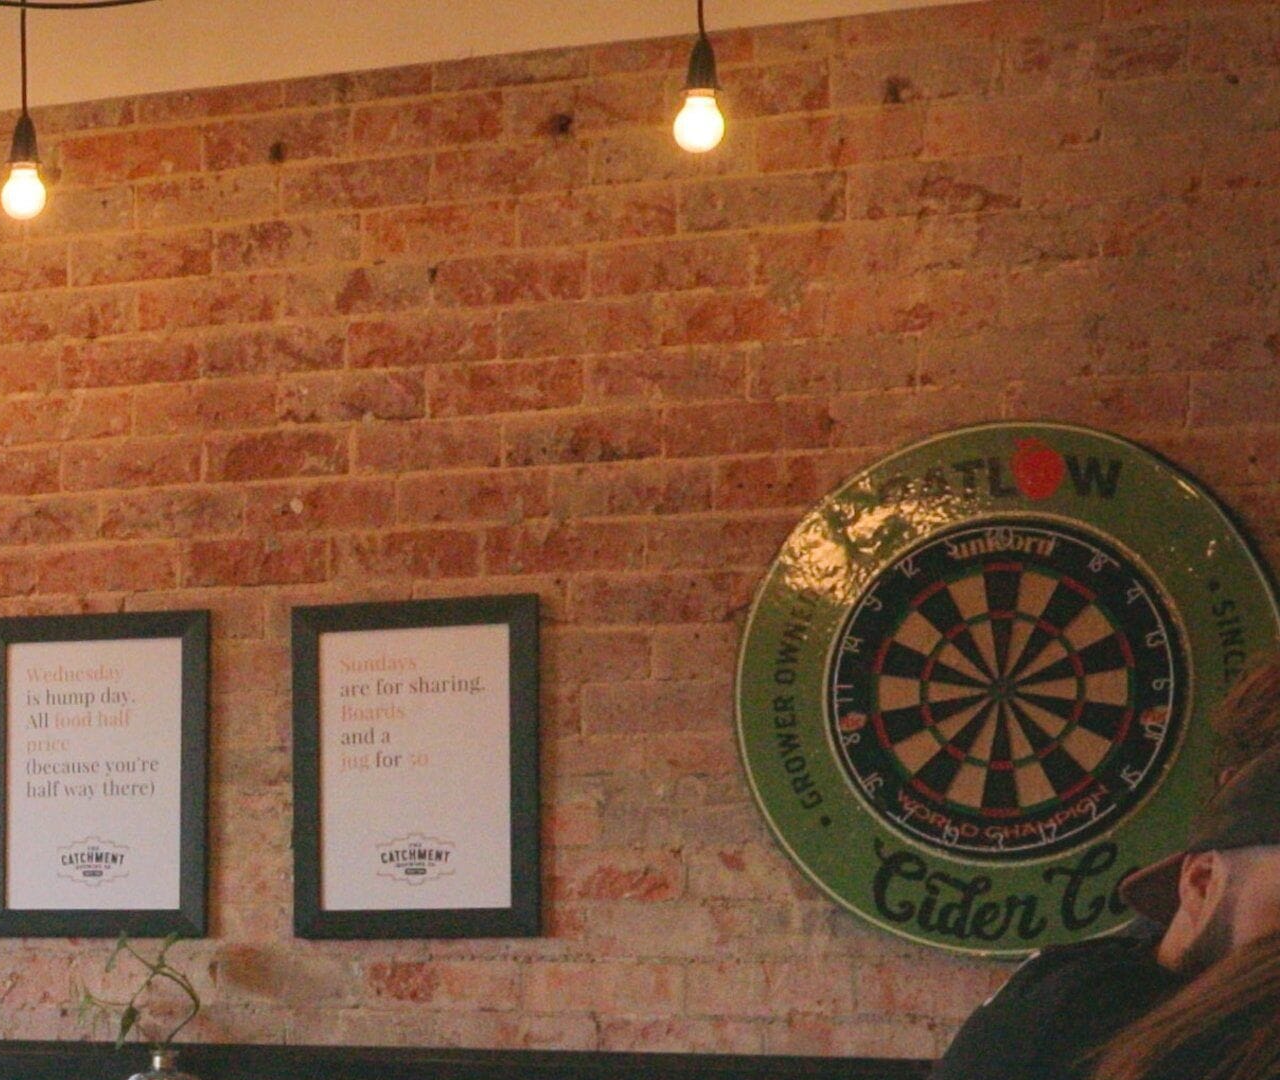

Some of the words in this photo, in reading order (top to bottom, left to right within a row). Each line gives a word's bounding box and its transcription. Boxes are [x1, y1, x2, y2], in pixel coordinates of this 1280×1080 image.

[340, 653, 417, 674] Sundays
[26, 665, 122, 685] Wednesday
[340, 683, 370, 698] are
[376, 678, 404, 695] for
[409, 675, 486, 695] sharing.
[26, 690, 40, 706] is
[46, 689, 96, 708] hump
[100, 687, 136, 707] day.
[25, 712, 49, 730] All
[54, 711, 92, 729] food
[98, 708, 133, 728] half
[341, 703, 406, 722] Boards
[340, 727, 375, 746] and
[381, 730, 391, 744] a
[340, 752, 371, 773] jug
[376, 751, 403, 768] for
[774, 695, 824, 811] GROWER
[26, 758, 100, 775] (because
[105, 757, 160, 778] you're
[26, 780, 61, 798] half
[64, 783, 96, 801] way
[102, 779, 156, 796] there)
[61, 852, 125, 866] CATCHMENT
[380, 848, 451, 864] CATCHMENT
[872, 837, 1049, 941] Cider
